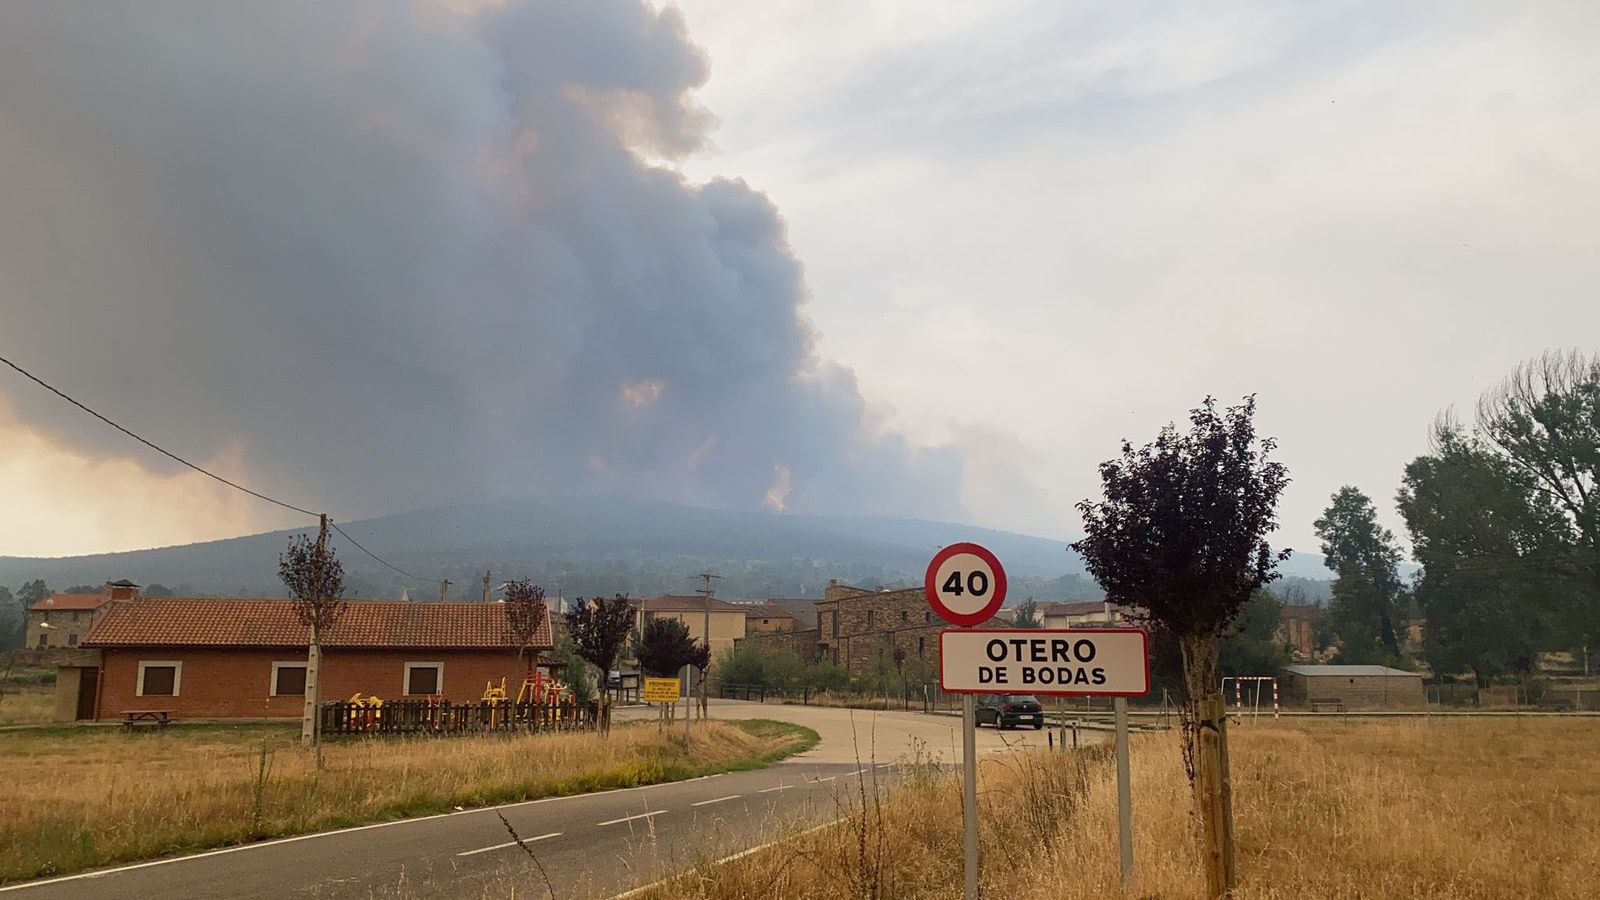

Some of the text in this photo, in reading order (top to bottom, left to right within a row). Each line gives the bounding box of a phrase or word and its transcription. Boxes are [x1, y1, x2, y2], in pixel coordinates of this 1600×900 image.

[942, 570, 989, 597] 40
[986, 638, 1097, 663] OTERO
[978, 666, 1106, 685] DE BODAS
